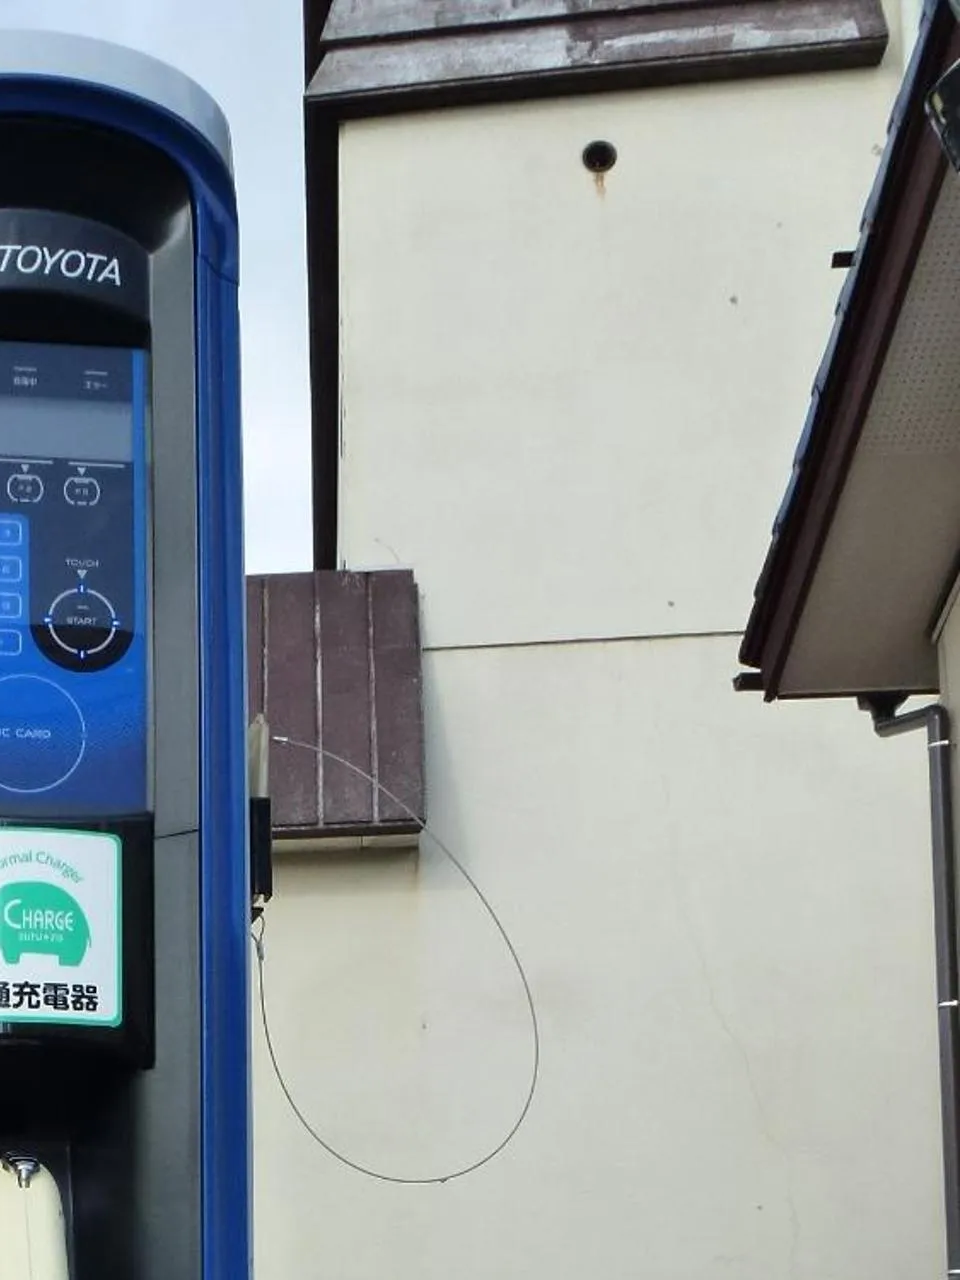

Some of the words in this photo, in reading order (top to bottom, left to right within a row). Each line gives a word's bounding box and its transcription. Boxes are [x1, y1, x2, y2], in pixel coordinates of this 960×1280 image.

[65, 558, 100, 568] TOUCH
[66, 616, 97, 625] START
[15, 728, 52, 739] CARD
[35, 850, 85, 884] Charger
[3, 898, 75, 932] CHARGE
